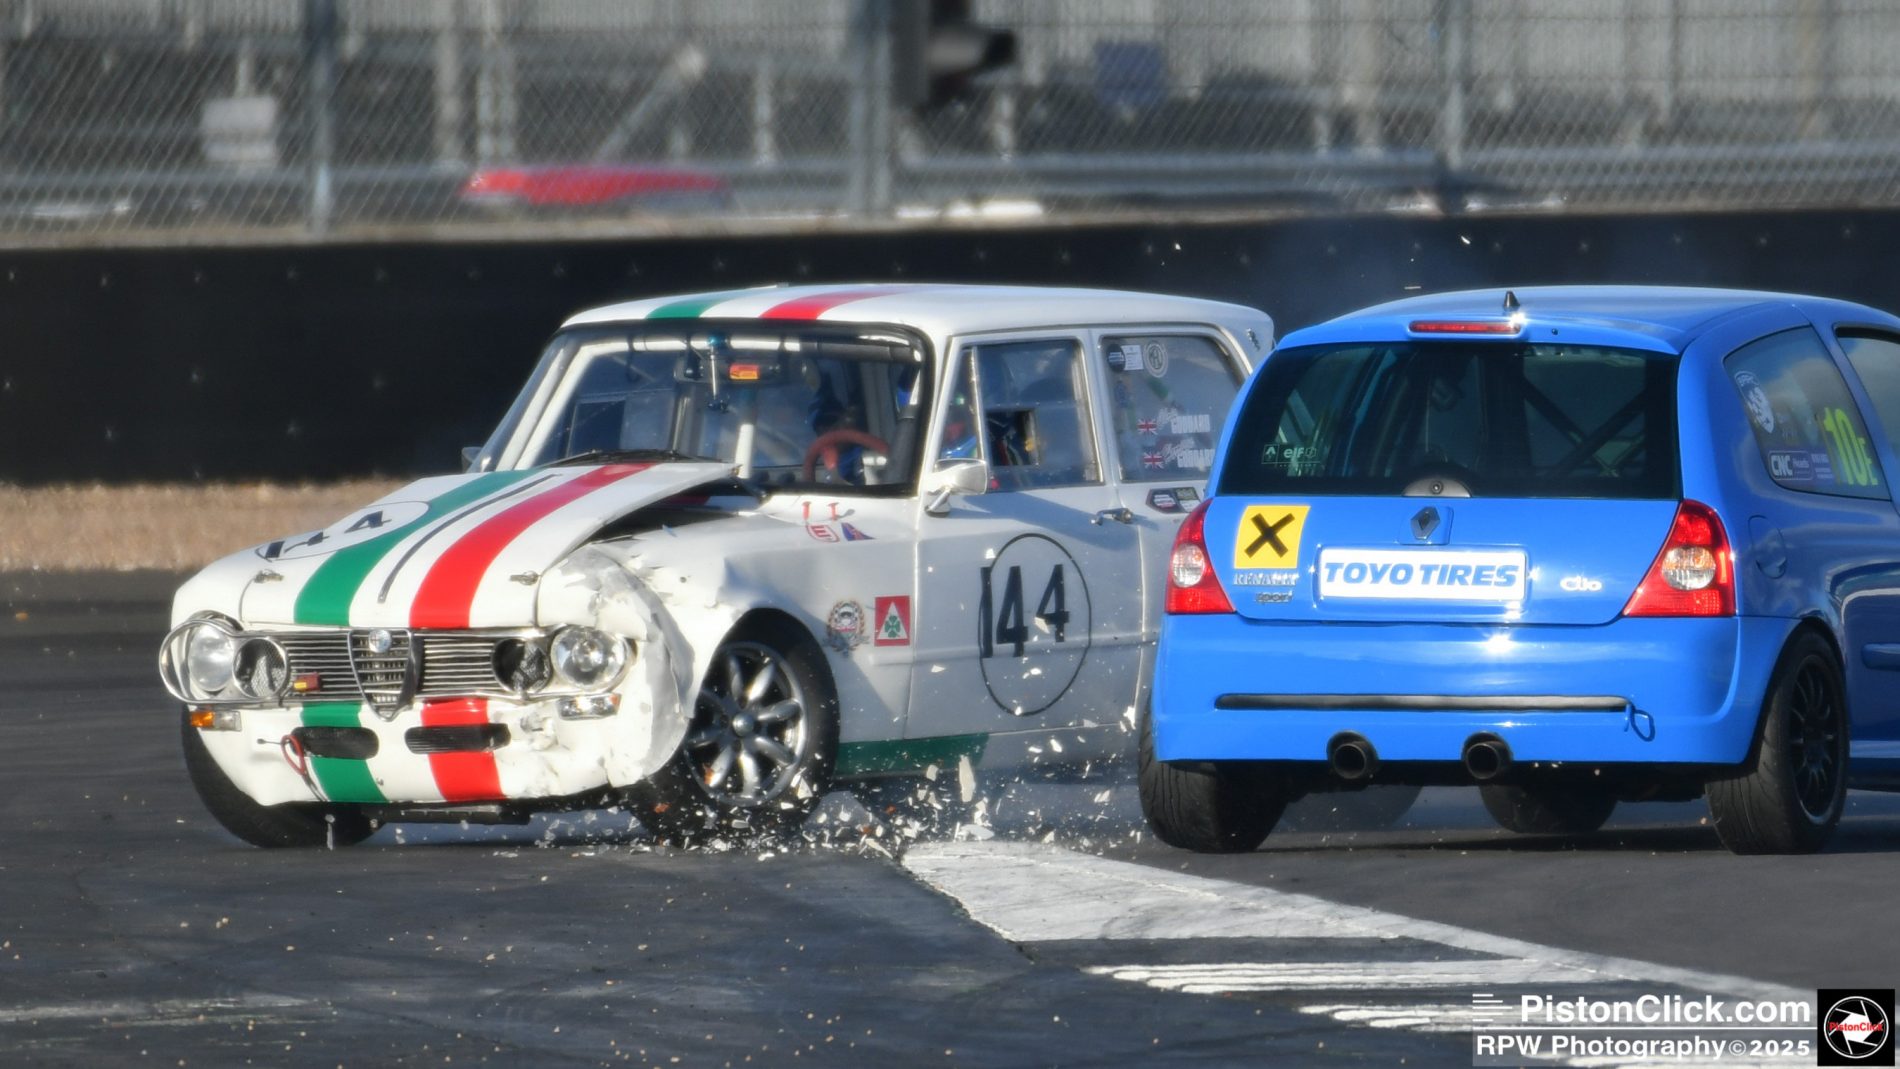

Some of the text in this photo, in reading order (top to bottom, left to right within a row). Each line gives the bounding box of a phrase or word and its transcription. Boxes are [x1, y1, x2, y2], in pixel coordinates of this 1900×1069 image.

[1771, 455, 1793, 476] CNC
[1324, 562, 1520, 587] TOYO TIRES
[980, 564, 1070, 659] 144
